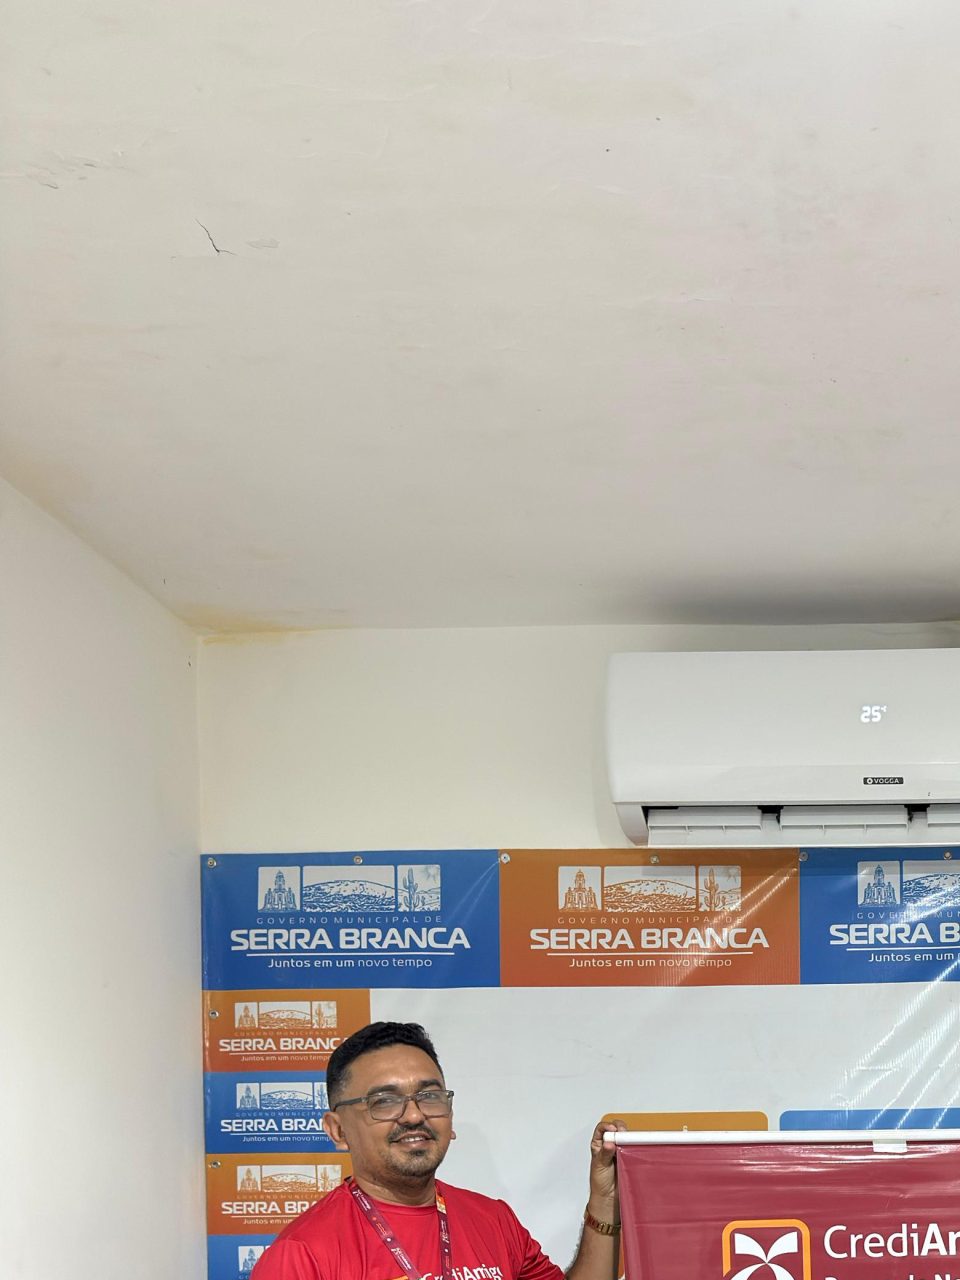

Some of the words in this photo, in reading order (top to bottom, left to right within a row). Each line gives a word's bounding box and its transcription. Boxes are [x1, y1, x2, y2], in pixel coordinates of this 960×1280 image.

[334, 916, 418, 924] MUNICIPAL
[230, 928, 333, 951] SERRA
[339, 927, 471, 949] BRANCA
[530, 928, 634, 949] SERRA
[641, 927, 769, 949] BRANCA
[830, 923, 933, 945] SERRA
[268, 958, 310, 968] Juntos
[314, 959, 332, 967] em
[336, 959, 355, 967] um
[358, 958, 389, 967] novo
[393, 957, 432, 968] tempo
[569, 958, 612, 968] Juntos
[615, 959, 634, 967] em
[637, 959, 655, 967] um
[659, 958, 690, 967] novo
[693, 958, 732, 968] tempo
[868, 953, 911, 963] Juntos
[914, 953, 933, 961] em
[936, 952, 954, 961] um
[219, 1038, 276, 1051] SERRA
[280, 1037, 348, 1050] BRANC
[221, 1119, 278, 1131] SERRA
[221, 1201, 281, 1214] SERRA
